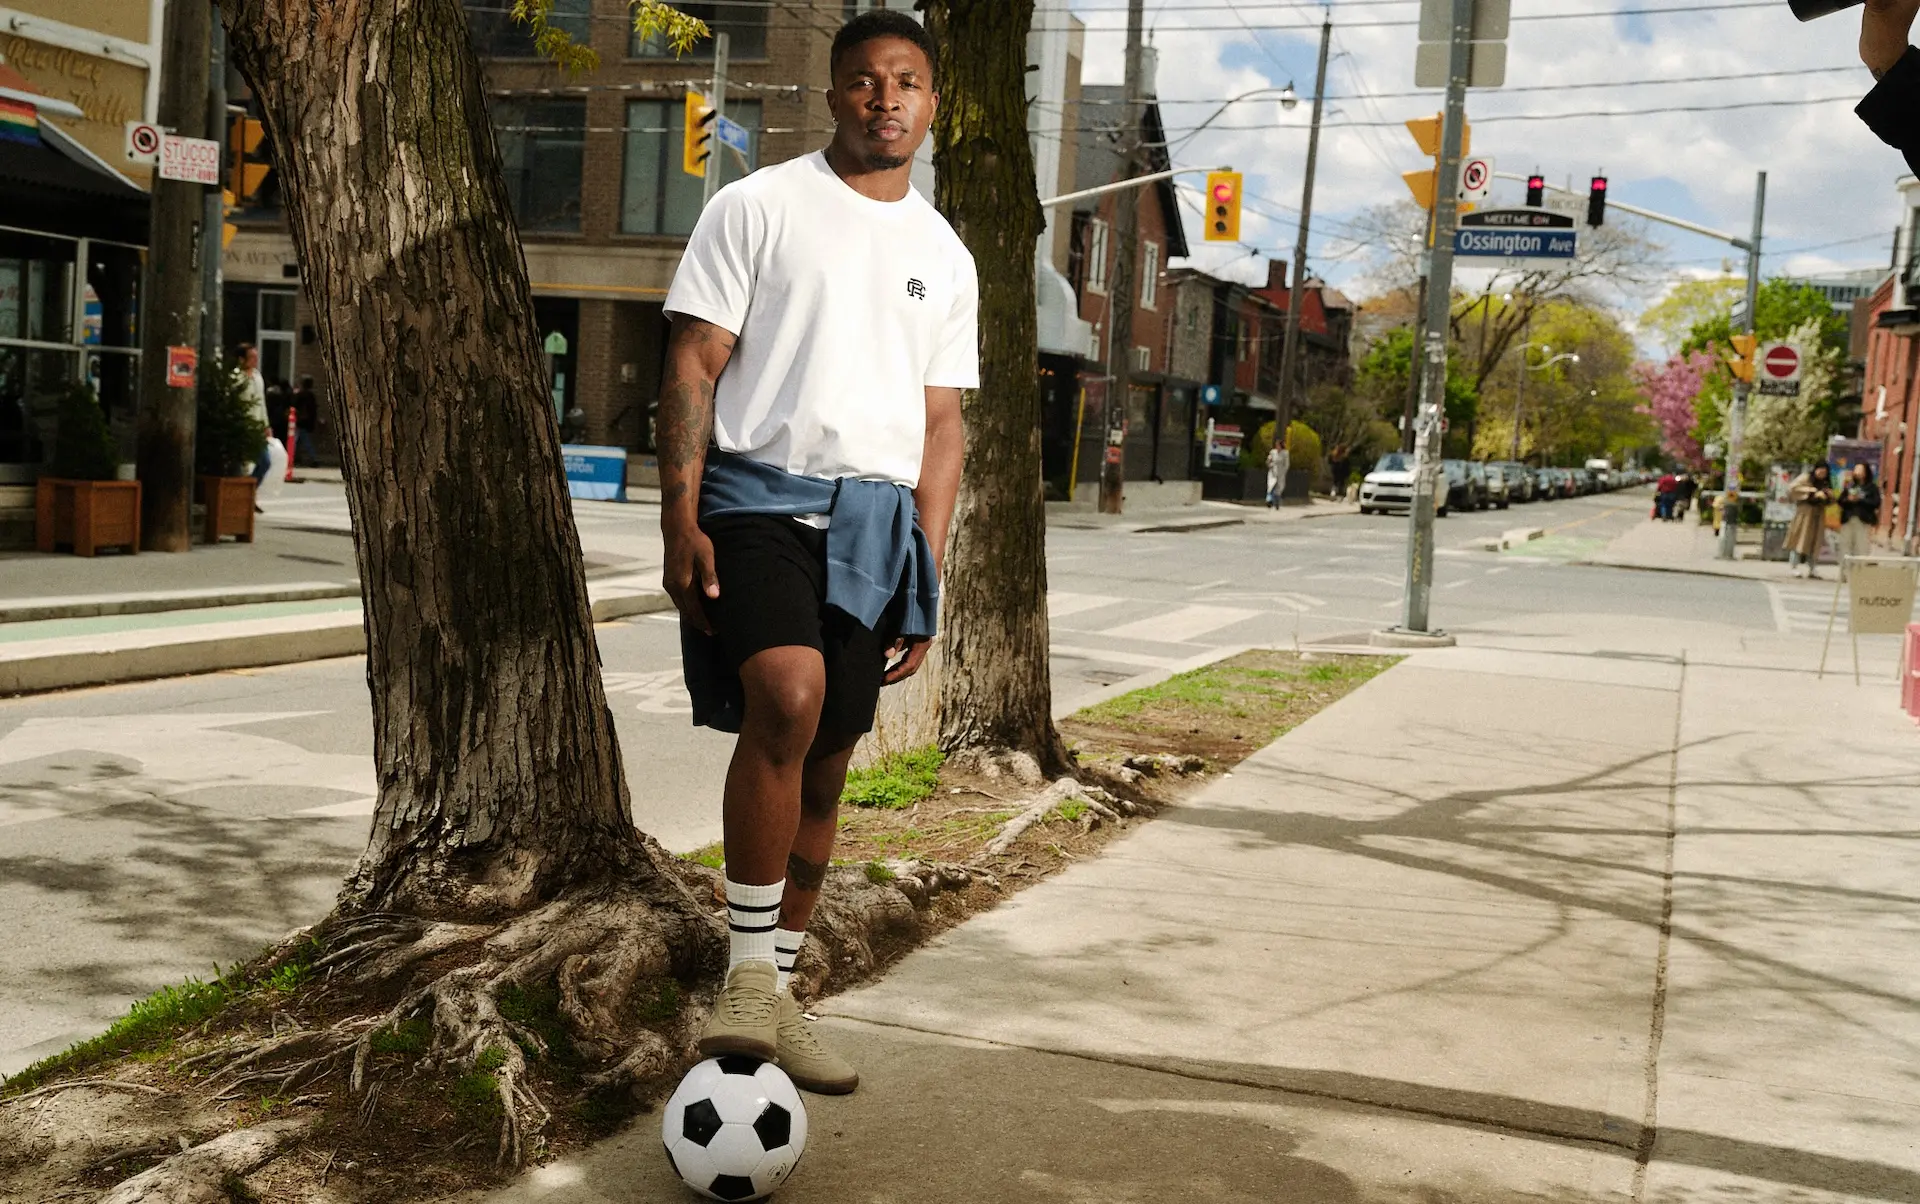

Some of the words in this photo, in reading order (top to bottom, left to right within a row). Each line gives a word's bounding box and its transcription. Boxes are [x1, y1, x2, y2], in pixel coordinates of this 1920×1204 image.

[164, 141, 217, 164] STUCCO
[1484, 214, 1512, 225] MEET
[1513, 214, 1530, 225] ME
[1532, 215, 1550, 225] ON
[1460, 231, 1541, 255] Ossington
[1548, 237, 1573, 252] Ave
[1858, 595, 1903, 608] nutbar
